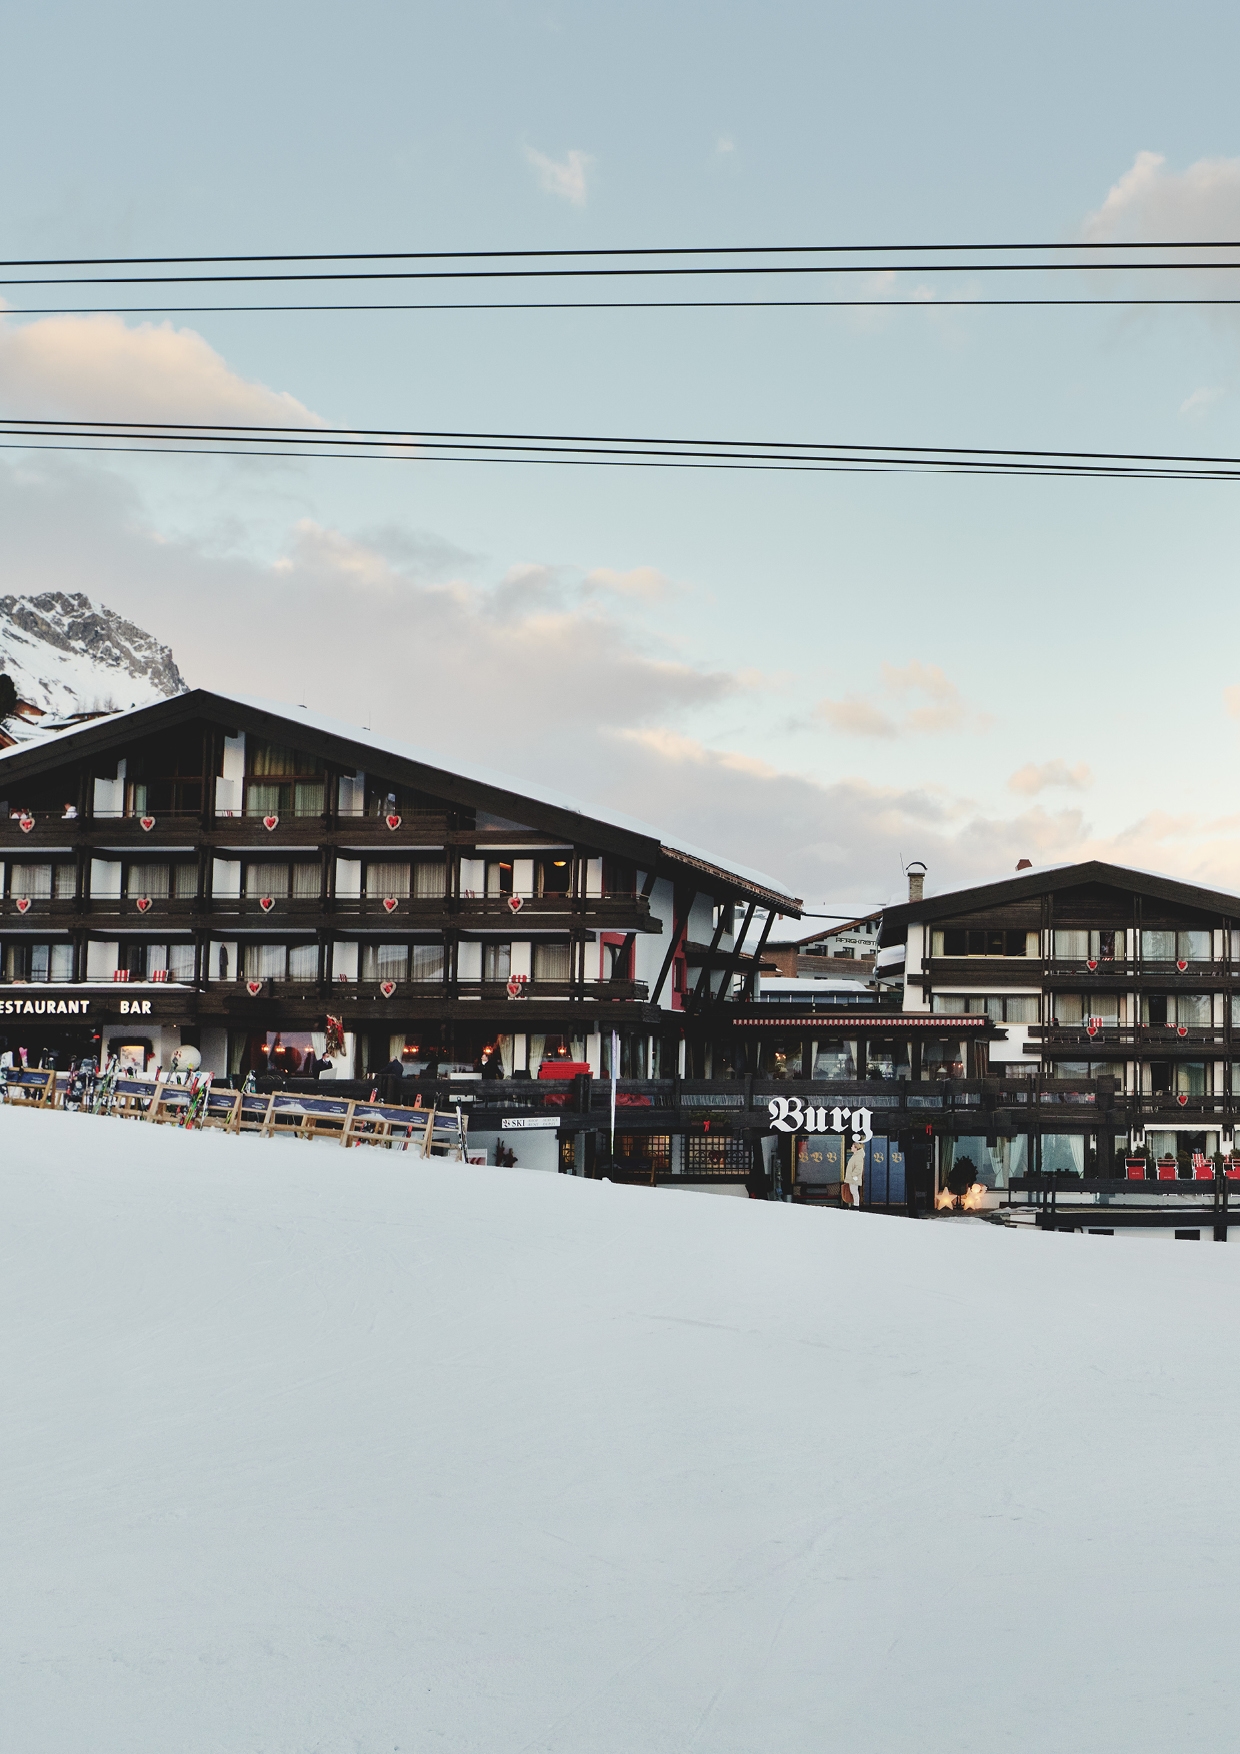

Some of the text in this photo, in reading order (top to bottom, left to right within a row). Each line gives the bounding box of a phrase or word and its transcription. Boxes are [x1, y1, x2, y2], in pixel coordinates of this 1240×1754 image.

[120, 1000, 152, 1014] BAR
[512, 1119, 525, 1127] SKI
[768, 1097, 874, 1144] Burg
